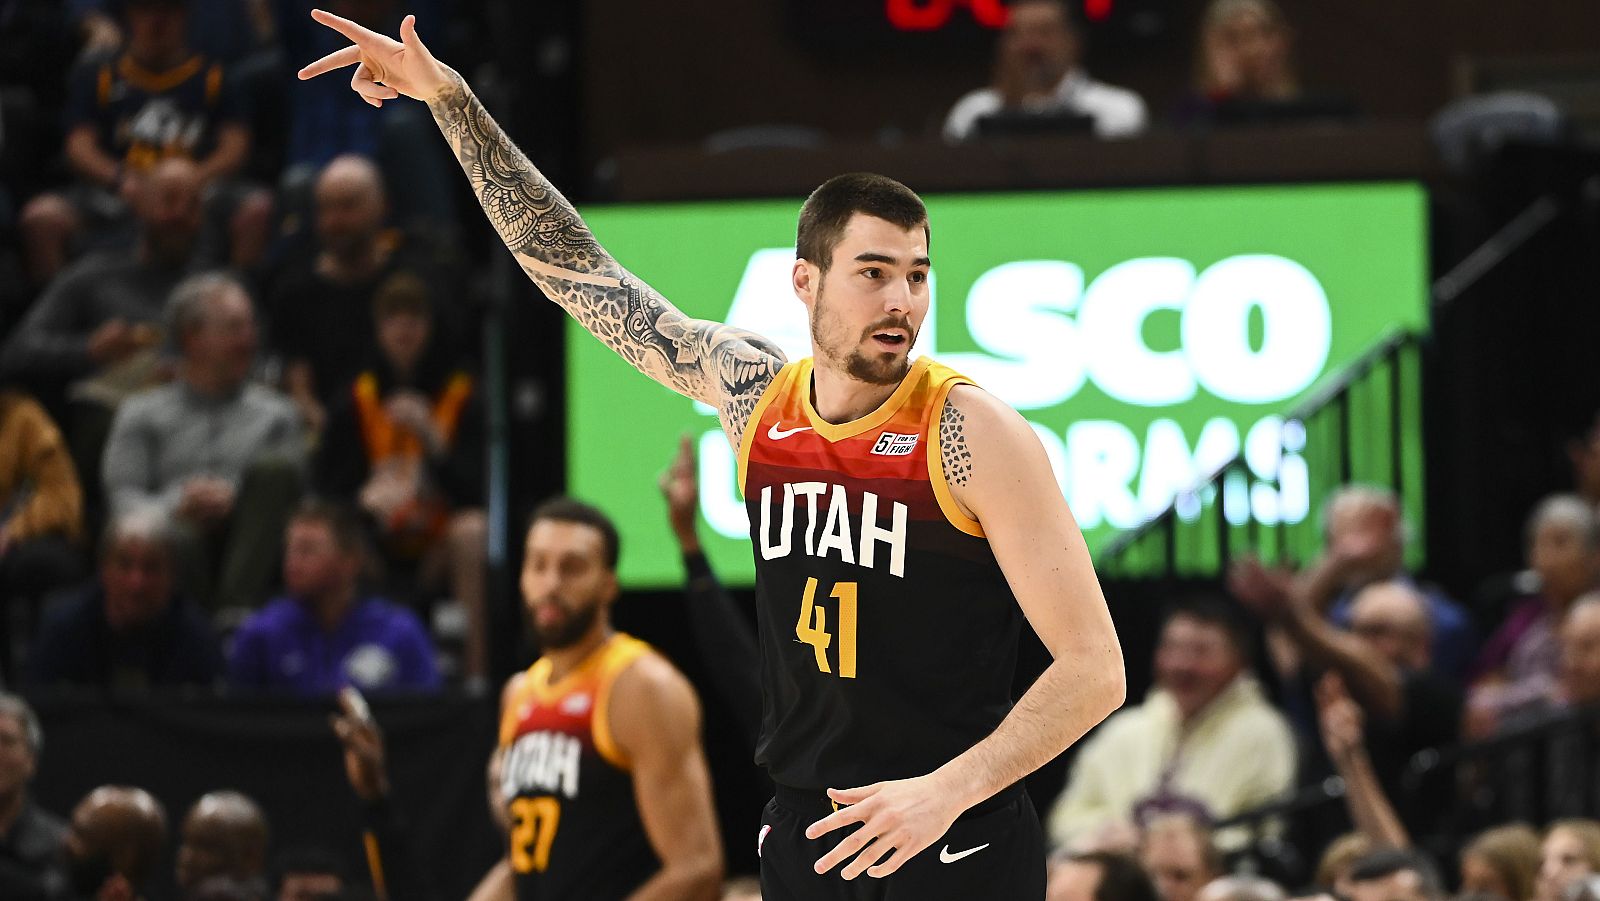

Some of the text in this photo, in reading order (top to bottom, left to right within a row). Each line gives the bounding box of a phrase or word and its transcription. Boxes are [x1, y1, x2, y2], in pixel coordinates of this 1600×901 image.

[874, 434, 893, 453] 5
[759, 481, 908, 579] UTAH
[796, 576, 858, 679] 41
[502, 731, 581, 799] UTAH
[510, 796, 561, 873] 27
